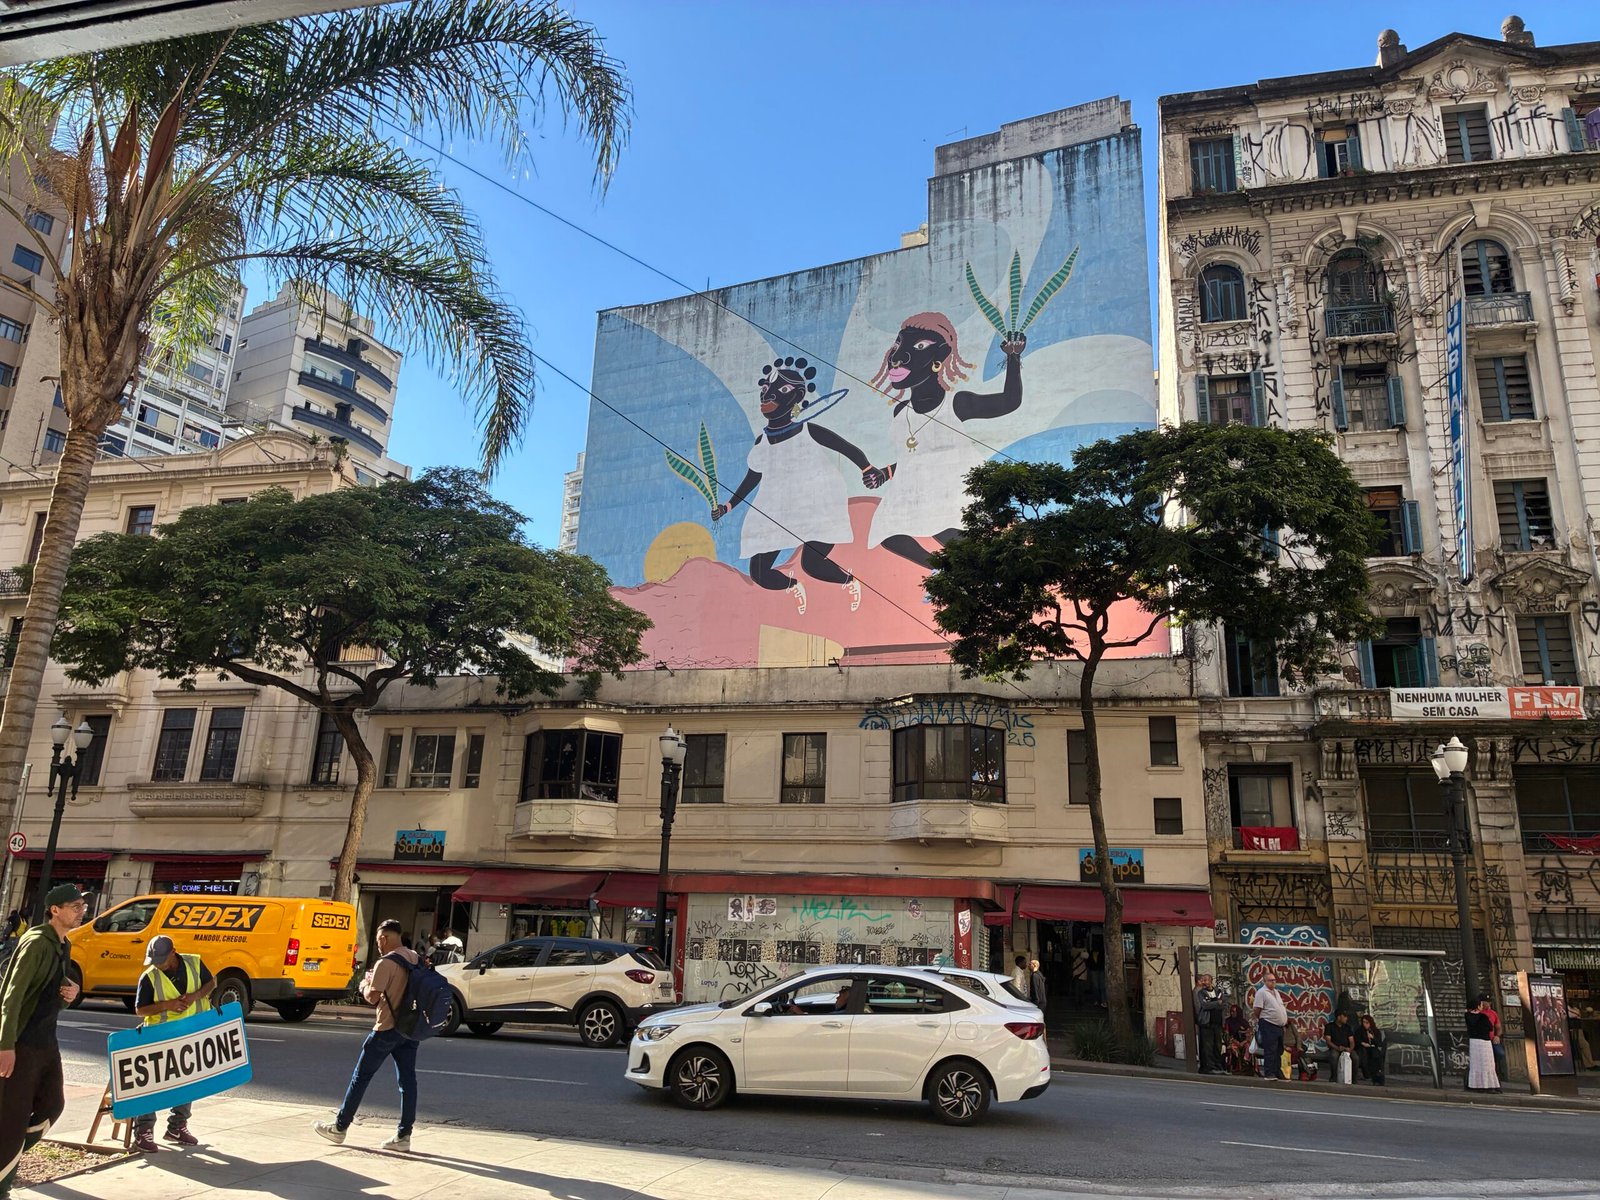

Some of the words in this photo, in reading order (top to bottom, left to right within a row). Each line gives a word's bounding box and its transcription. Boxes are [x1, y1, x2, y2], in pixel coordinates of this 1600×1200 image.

[1396, 692, 1452, 703] NENHUMA
[1455, 691, 1502, 702] MULHER
[1513, 691, 1577, 709] FLM
[1422, 706, 1446, 717] SEM
[1449, 706, 1479, 717] CASA
[11, 837, 24, 848] 40
[398, 839, 442, 858] Sampa
[1084, 857, 1141, 881] Spa
[168, 905, 260, 929] SEDEX
[313, 914, 350, 929] SEDEX
[193, 934, 221, 942] MANDOU,
[118, 1028, 242, 1091] ESTACIONE
